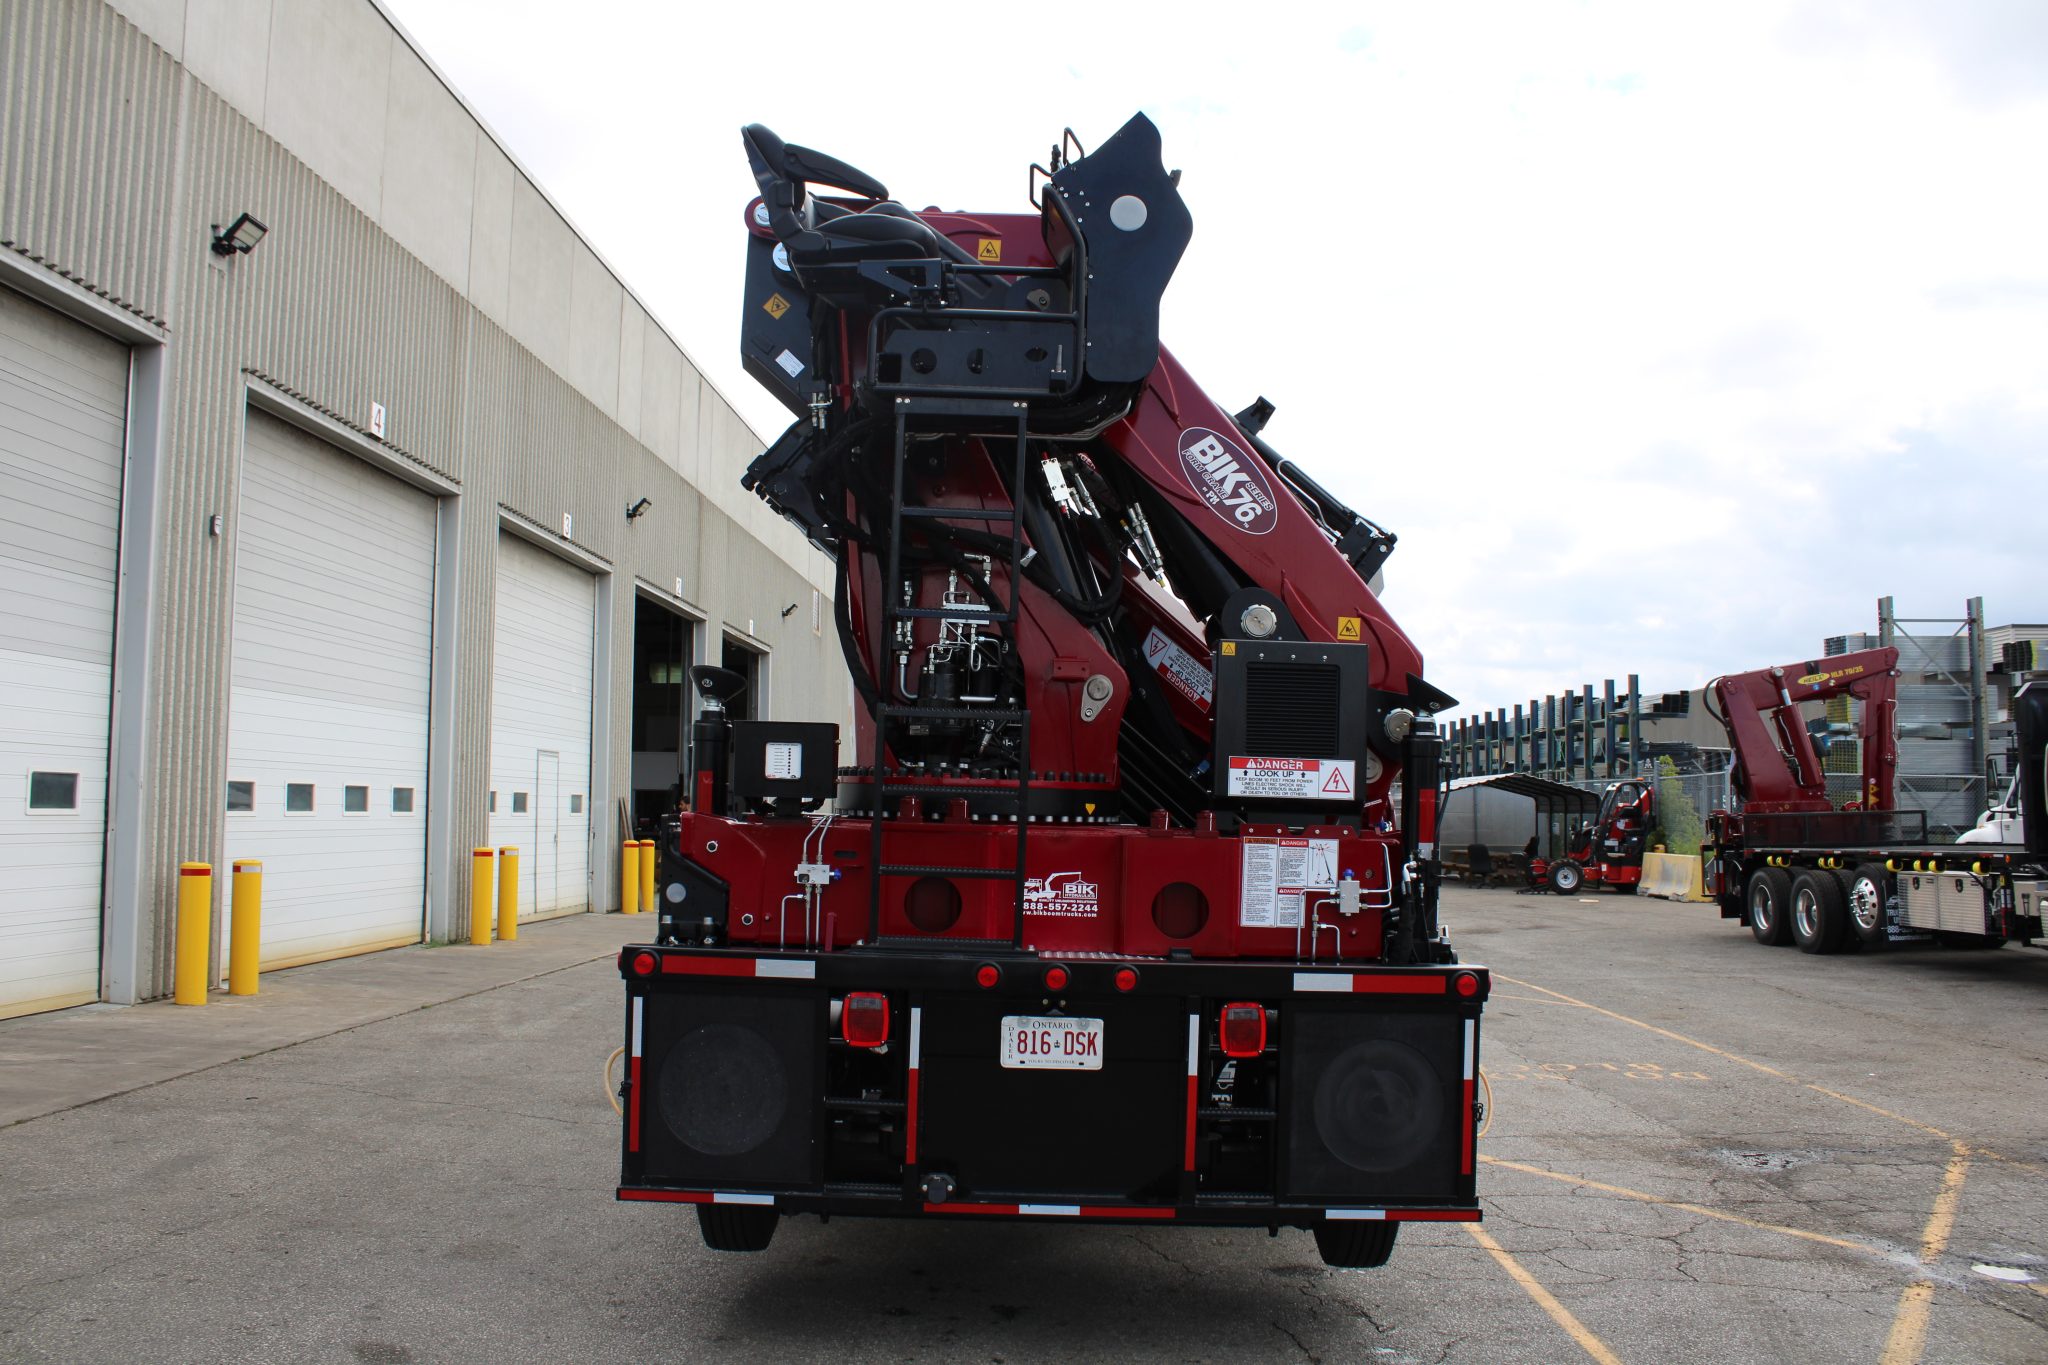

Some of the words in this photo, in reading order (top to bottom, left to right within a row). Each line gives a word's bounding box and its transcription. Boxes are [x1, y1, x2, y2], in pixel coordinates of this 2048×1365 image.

[374, 408, 382, 432] 4
[1182, 449, 1206, 473] FORM
[1202, 471, 1230, 500] CRANE
[1188, 434, 1252, 497] BIK
[1205, 490, 1220, 505] PM
[1223, 487, 1263, 522] 76
[1245, 481, 1274, 511] SERIES
[1166, 670, 1195, 699] DANGER
[1175, 669, 1184, 677] UP
[1182, 674, 1199, 690] LOOK
[1256, 759, 1304, 770] DANGER
[1065, 884, 1095, 895] BIK
[1032, 1020, 1073, 1029] ONTARIO
[1017, 1030, 1051, 1055] 816
[1064, 1030, 1098, 1056] DSK
